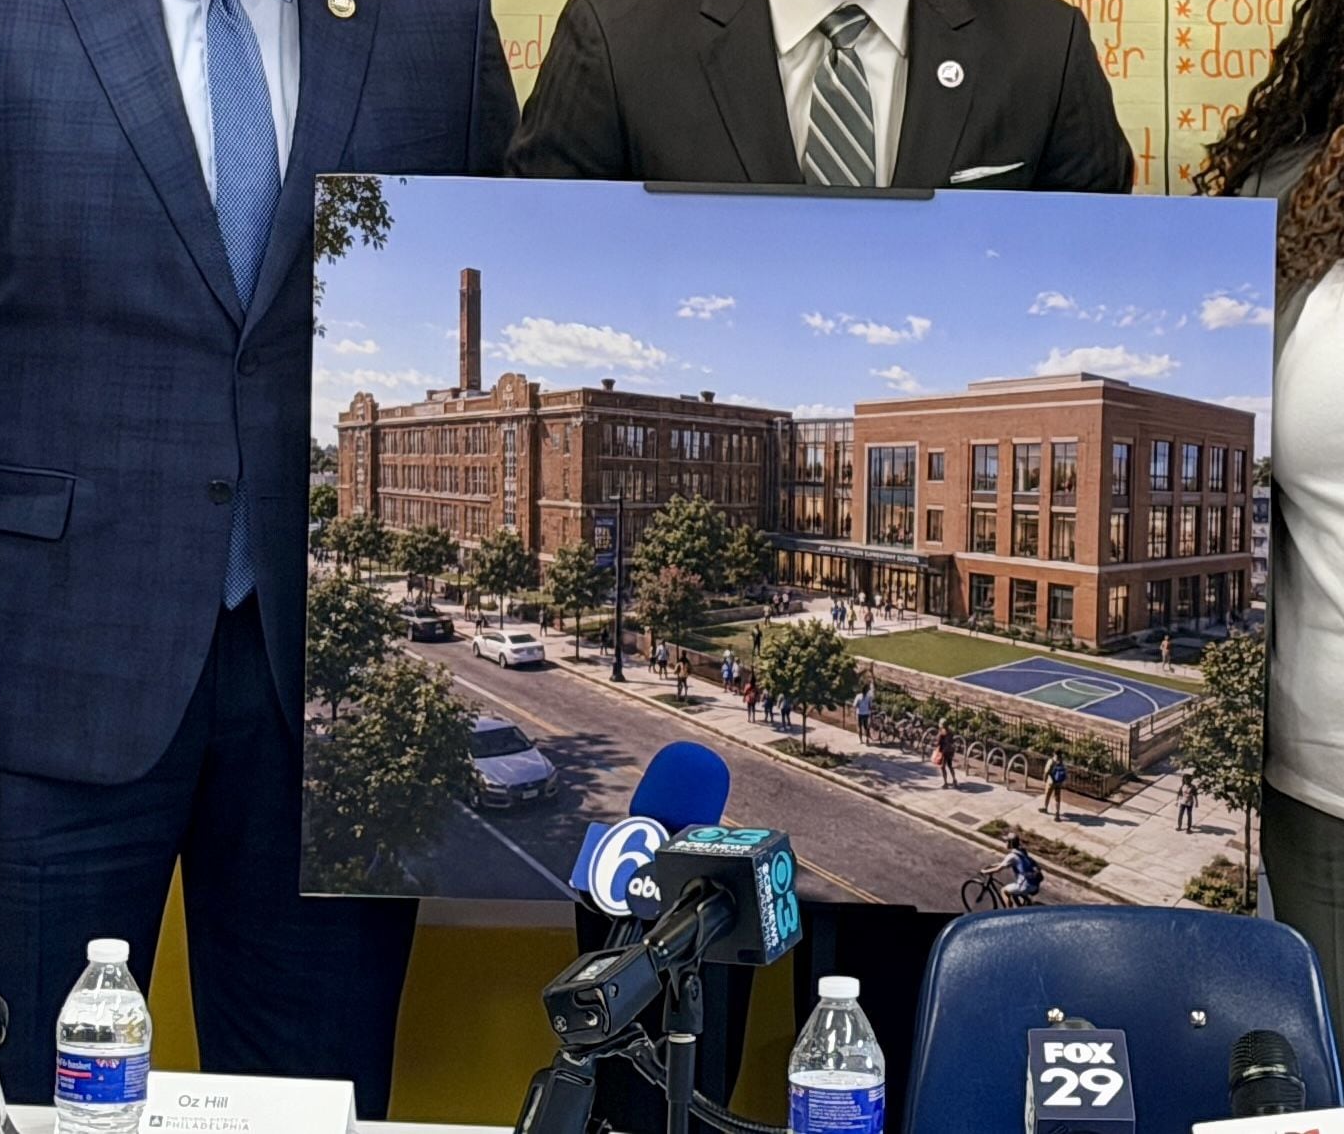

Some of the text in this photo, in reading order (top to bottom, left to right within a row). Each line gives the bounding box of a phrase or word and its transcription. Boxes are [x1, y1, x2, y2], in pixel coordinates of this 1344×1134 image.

[1044, 1042, 1116, 1064] FOX
[1040, 1067, 1124, 1107] 29
[178, 1094, 229, 1109] Oz Hill
[165, 1119, 250, 1131] PHILADELPHIA
